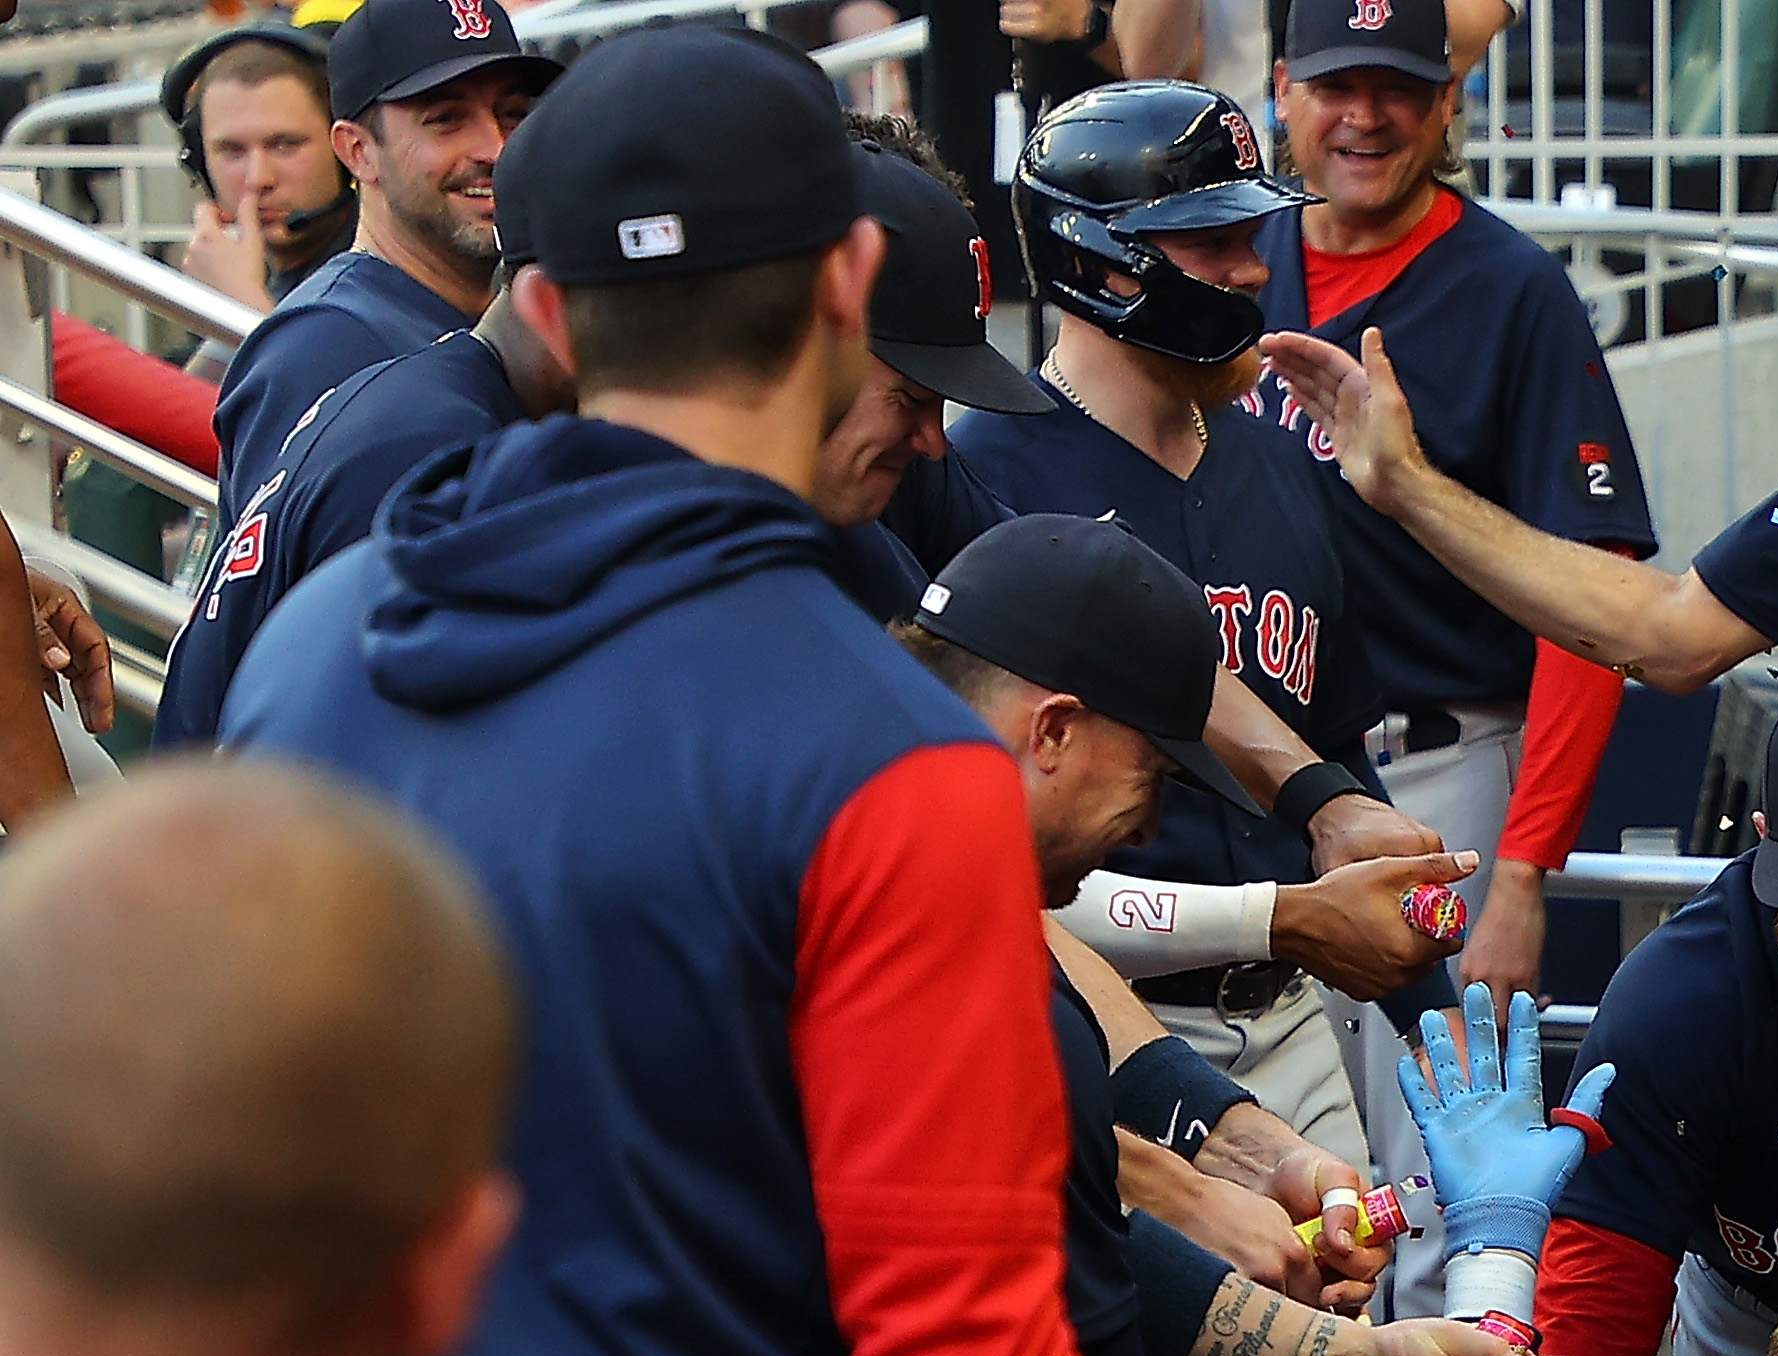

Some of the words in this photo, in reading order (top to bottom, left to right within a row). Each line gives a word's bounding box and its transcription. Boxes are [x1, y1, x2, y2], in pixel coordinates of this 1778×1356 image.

[1220, 112, 1257, 170] B
[1587, 462, 1615, 495] 2
[1204, 583, 1320, 706] TON
[1109, 889, 1177, 933] 2
